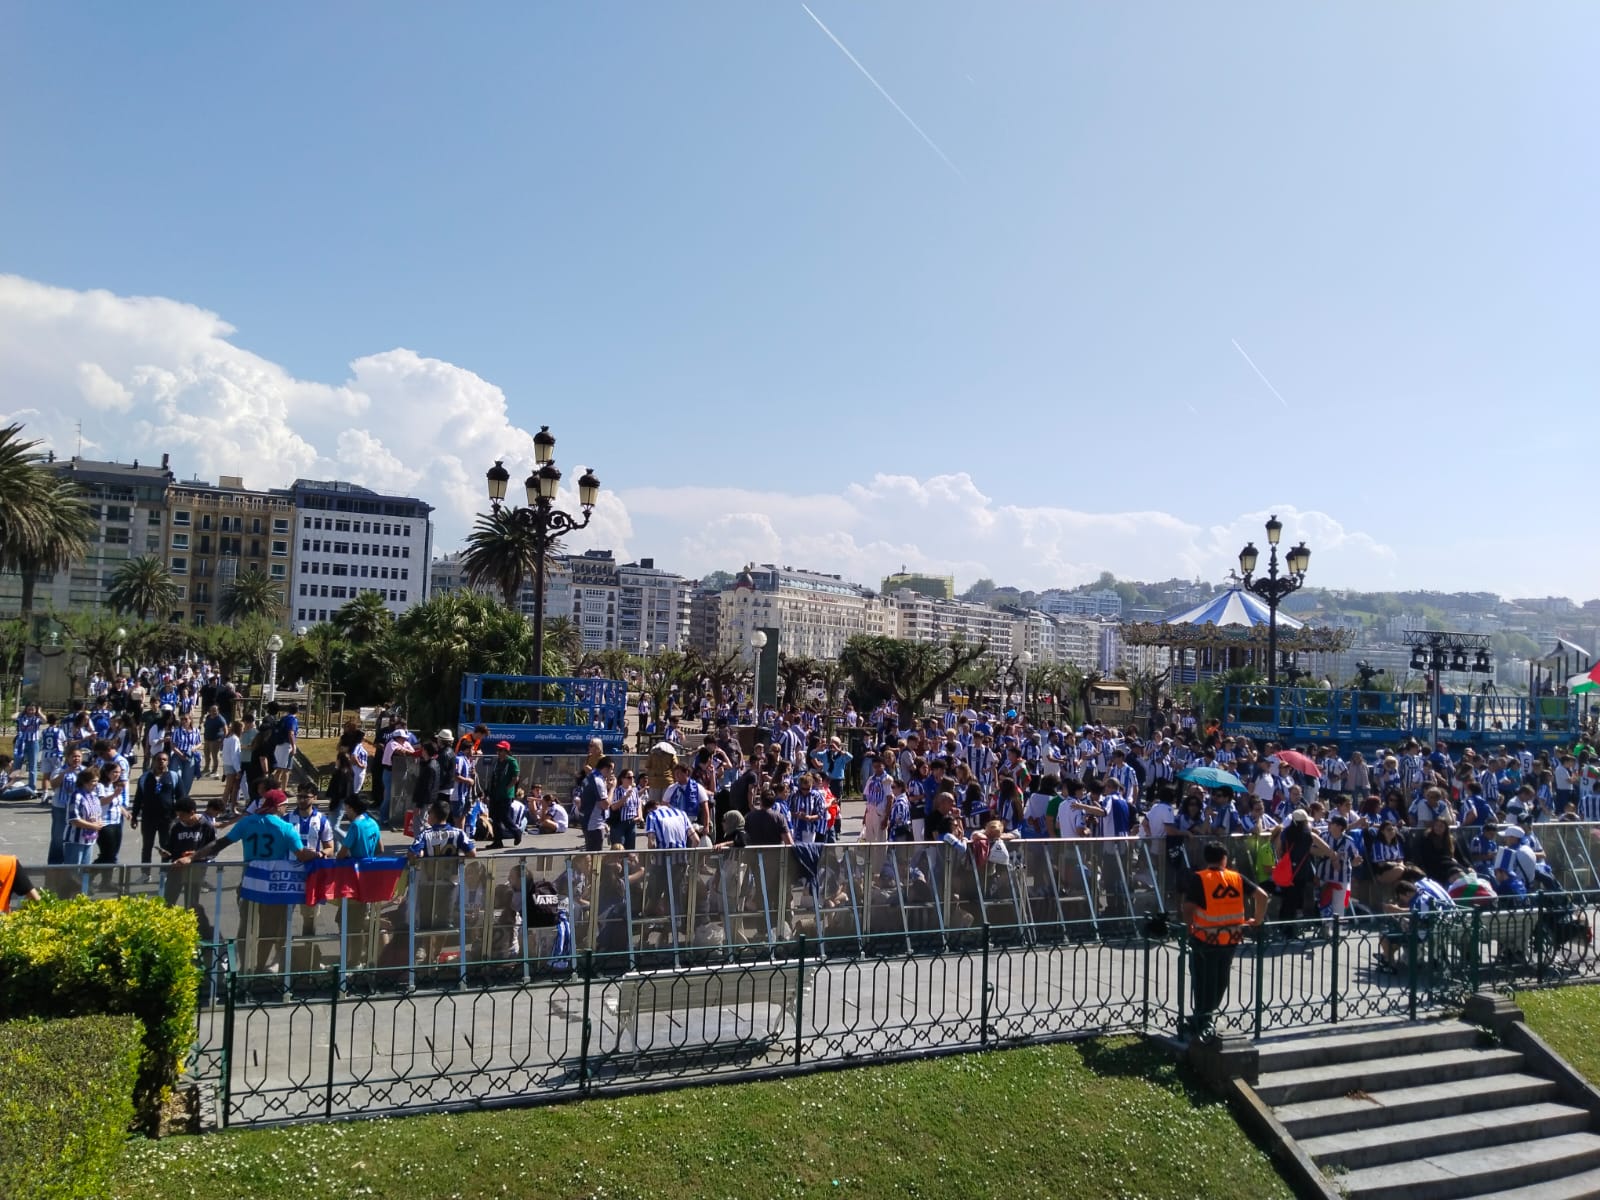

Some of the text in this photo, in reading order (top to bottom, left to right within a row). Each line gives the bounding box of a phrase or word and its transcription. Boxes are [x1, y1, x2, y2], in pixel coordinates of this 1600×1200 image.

[46, 737, 53, 749] 9
[247, 832, 275, 858] 13
[268, 882, 305, 892] REAL
[532, 893, 559, 905] VANS
